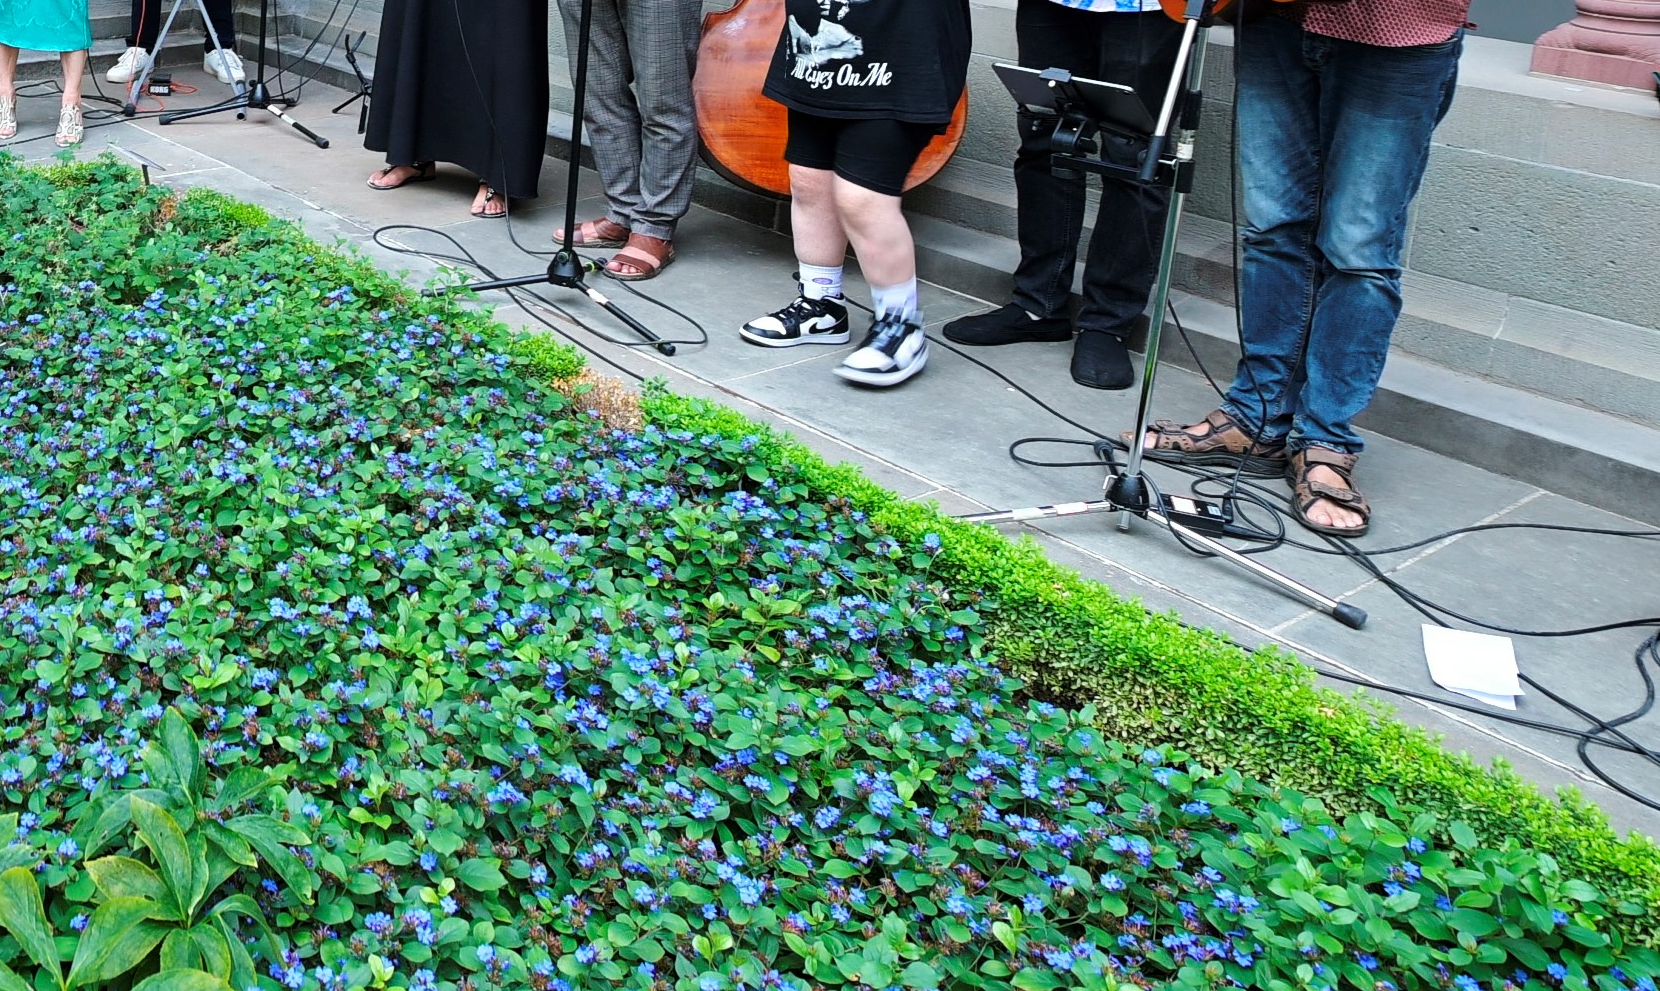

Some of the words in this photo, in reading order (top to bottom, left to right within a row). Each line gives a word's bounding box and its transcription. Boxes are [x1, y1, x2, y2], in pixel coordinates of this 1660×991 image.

[805, 62, 835, 90] Eyez
[836, 63, 861, 87] On
[860, 62, 893, 87] Me
